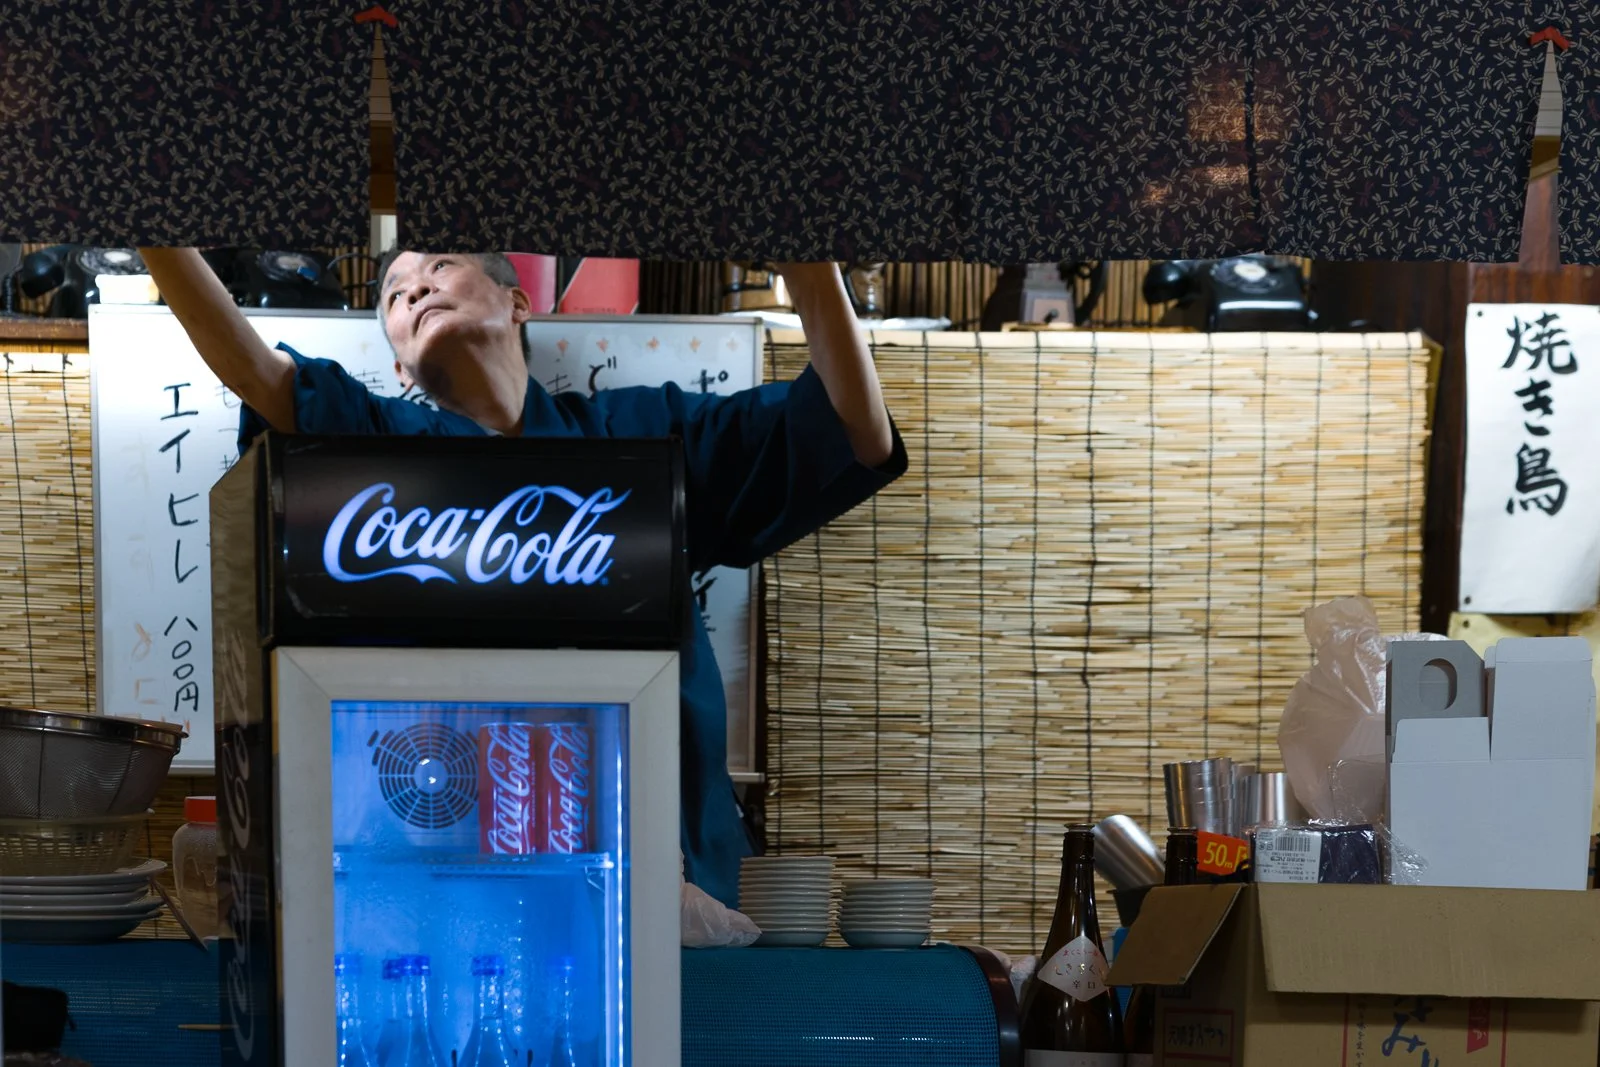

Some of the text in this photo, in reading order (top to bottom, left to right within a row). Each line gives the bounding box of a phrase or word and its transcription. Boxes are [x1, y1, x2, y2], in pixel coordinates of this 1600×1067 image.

[1501, 311, 1578, 517] 焼き鳥
[322, 482, 632, 586] Coca-Cola
[221, 625, 253, 1061] Coca-Cola
[487, 723, 531, 854] Coca-Cola
[548, 723, 590, 854] Coca-Cola
